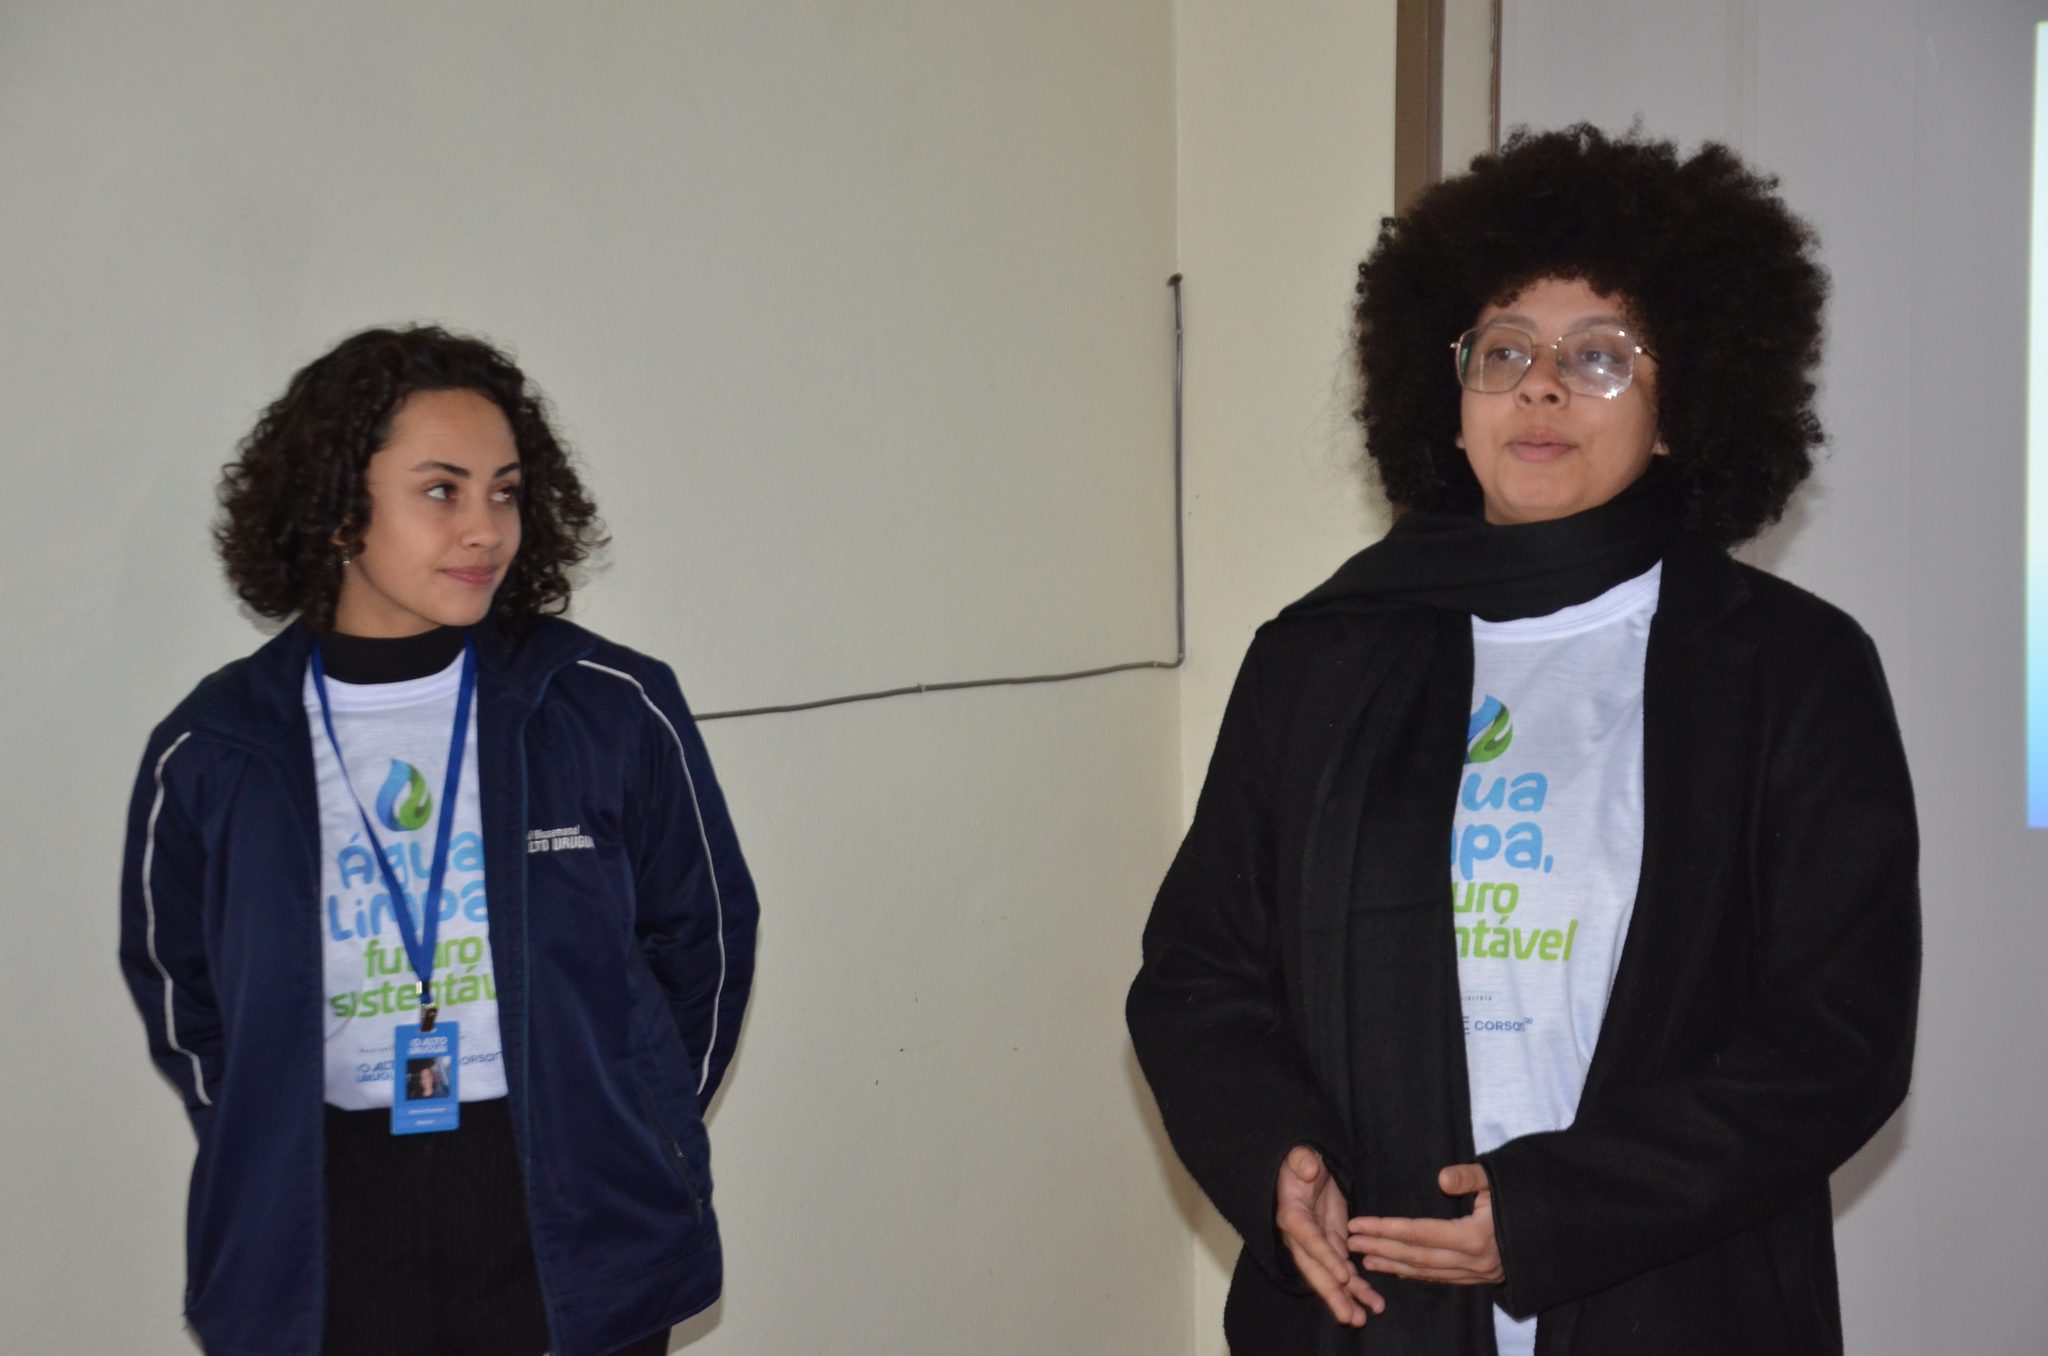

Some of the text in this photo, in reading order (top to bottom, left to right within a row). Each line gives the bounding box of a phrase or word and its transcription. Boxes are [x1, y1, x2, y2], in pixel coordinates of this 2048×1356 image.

[1462, 772, 1548, 813] ua
[1452, 821, 1554, 880] pa,
[1453, 882, 1519, 914] uro
[1455, 915, 1579, 962] ntável
